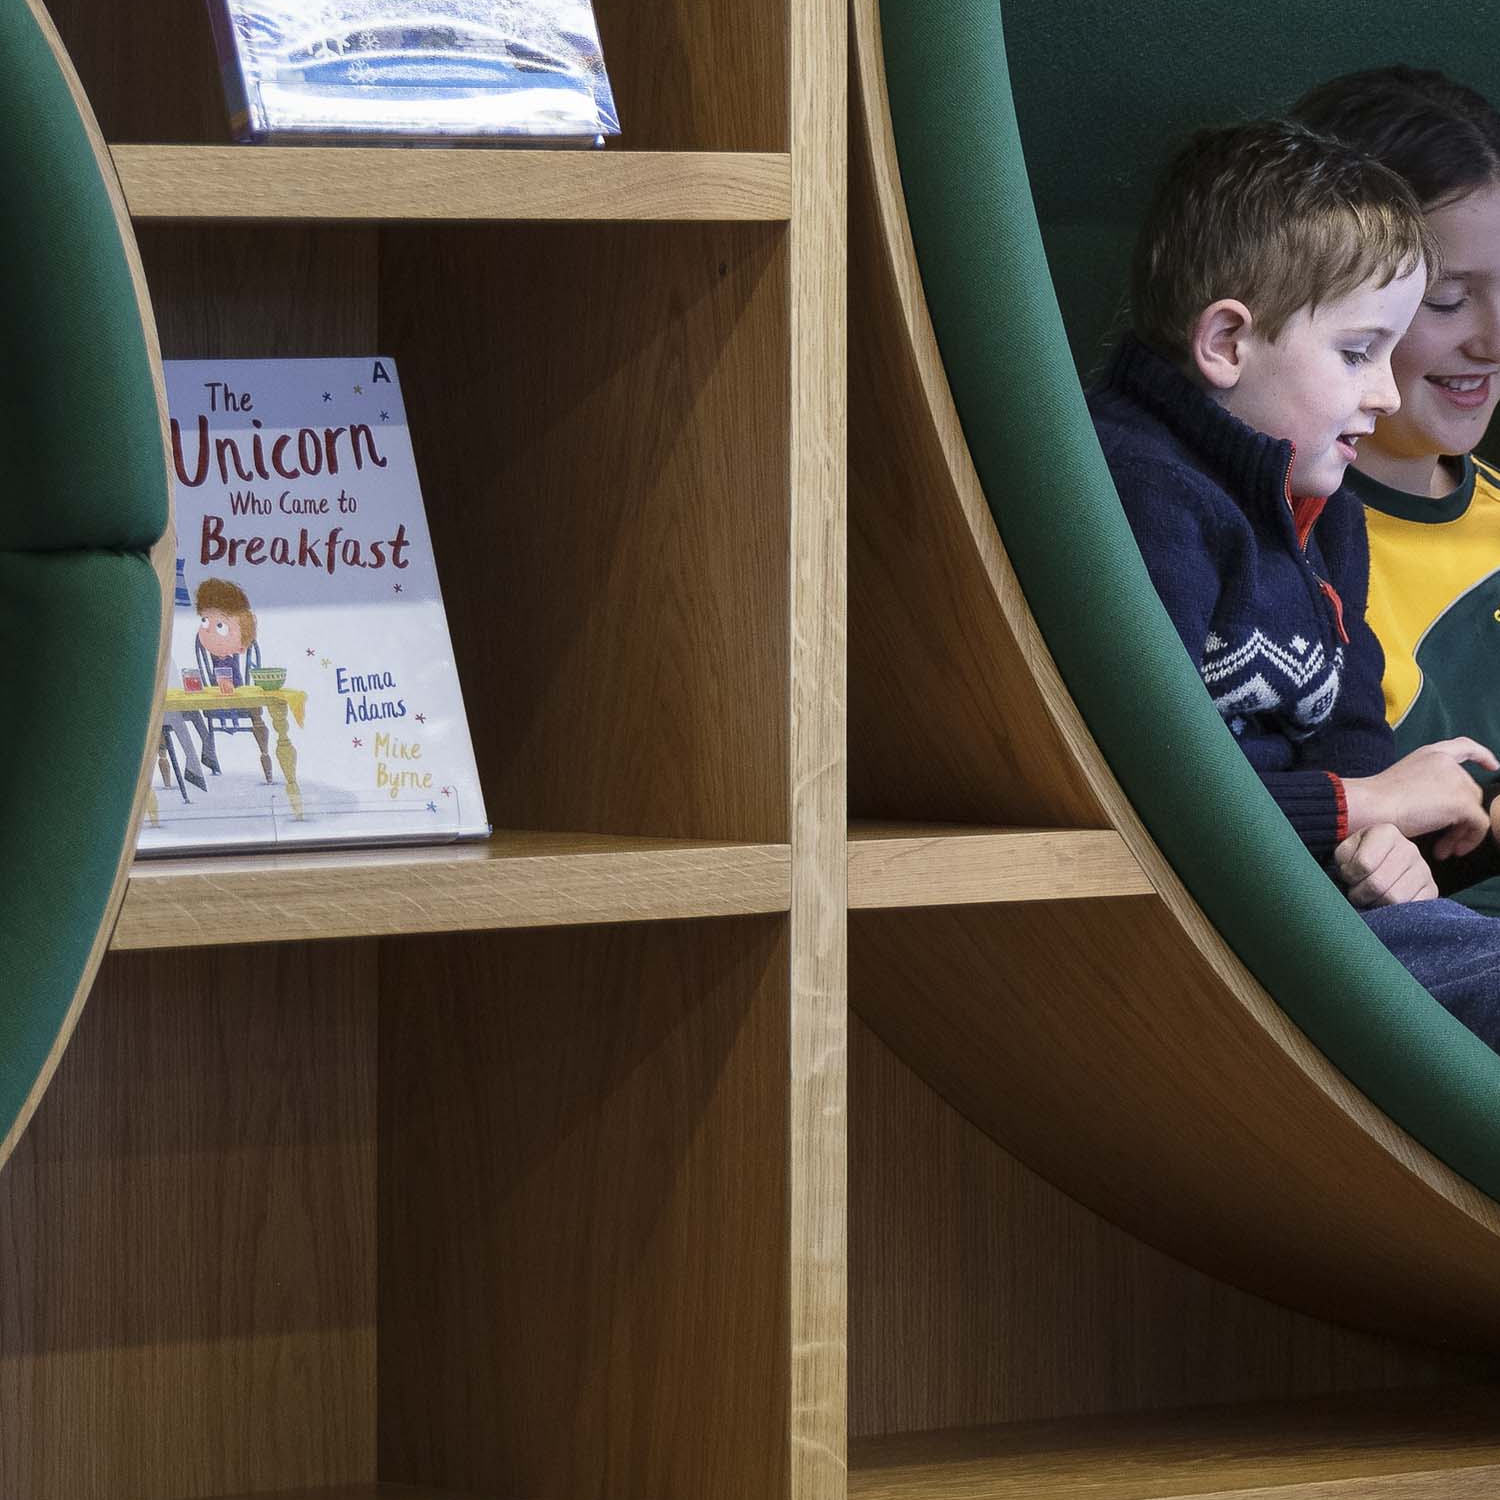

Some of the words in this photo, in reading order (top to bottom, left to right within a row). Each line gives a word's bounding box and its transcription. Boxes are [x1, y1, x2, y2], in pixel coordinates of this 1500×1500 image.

[371, 360, 392, 384] A
[204, 382, 254, 412] The
[170, 414, 388, 488] Unicorn
[229, 490, 272, 515] Who
[278, 490, 330, 515] Came
[337, 488, 358, 514] to
[200, 514, 411, 576] Breakfast
[336, 667, 397, 695] Emma
[345, 695, 407, 725] Adams
[374, 731, 423, 761] Mike
[376, 761, 434, 800] Byrne
